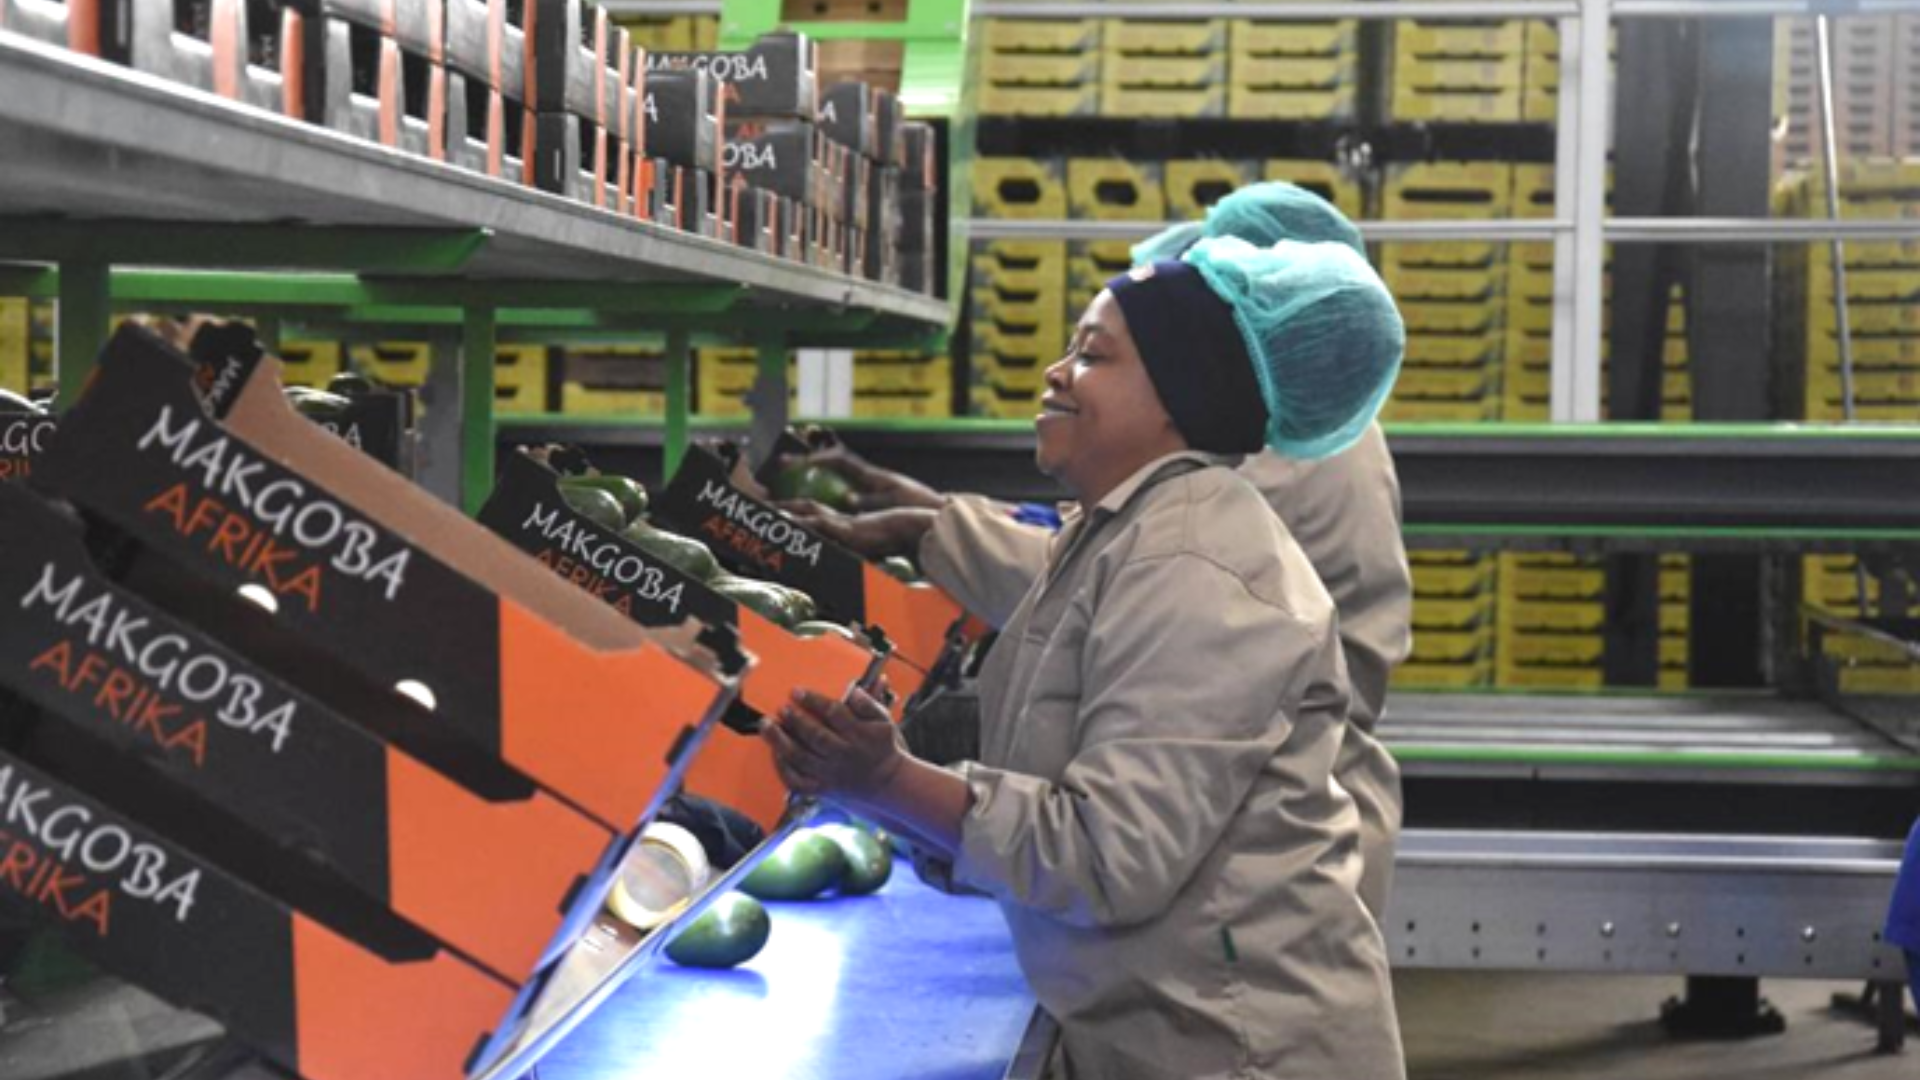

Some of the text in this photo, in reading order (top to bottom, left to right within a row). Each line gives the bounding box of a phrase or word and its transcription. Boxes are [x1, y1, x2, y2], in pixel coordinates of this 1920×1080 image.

[137, 404, 412, 600] MAKGOBA
[143, 482, 324, 613] AFRIKA
[521, 503, 686, 613] MAKGOBA
[696, 479, 823, 567] MAKGOBA
[20, 562, 298, 753] MAKGOBA
[29, 640, 209, 767] AFRIKA
[0, 765, 201, 922] KGOBA
[0, 830, 111, 937] RIKA
